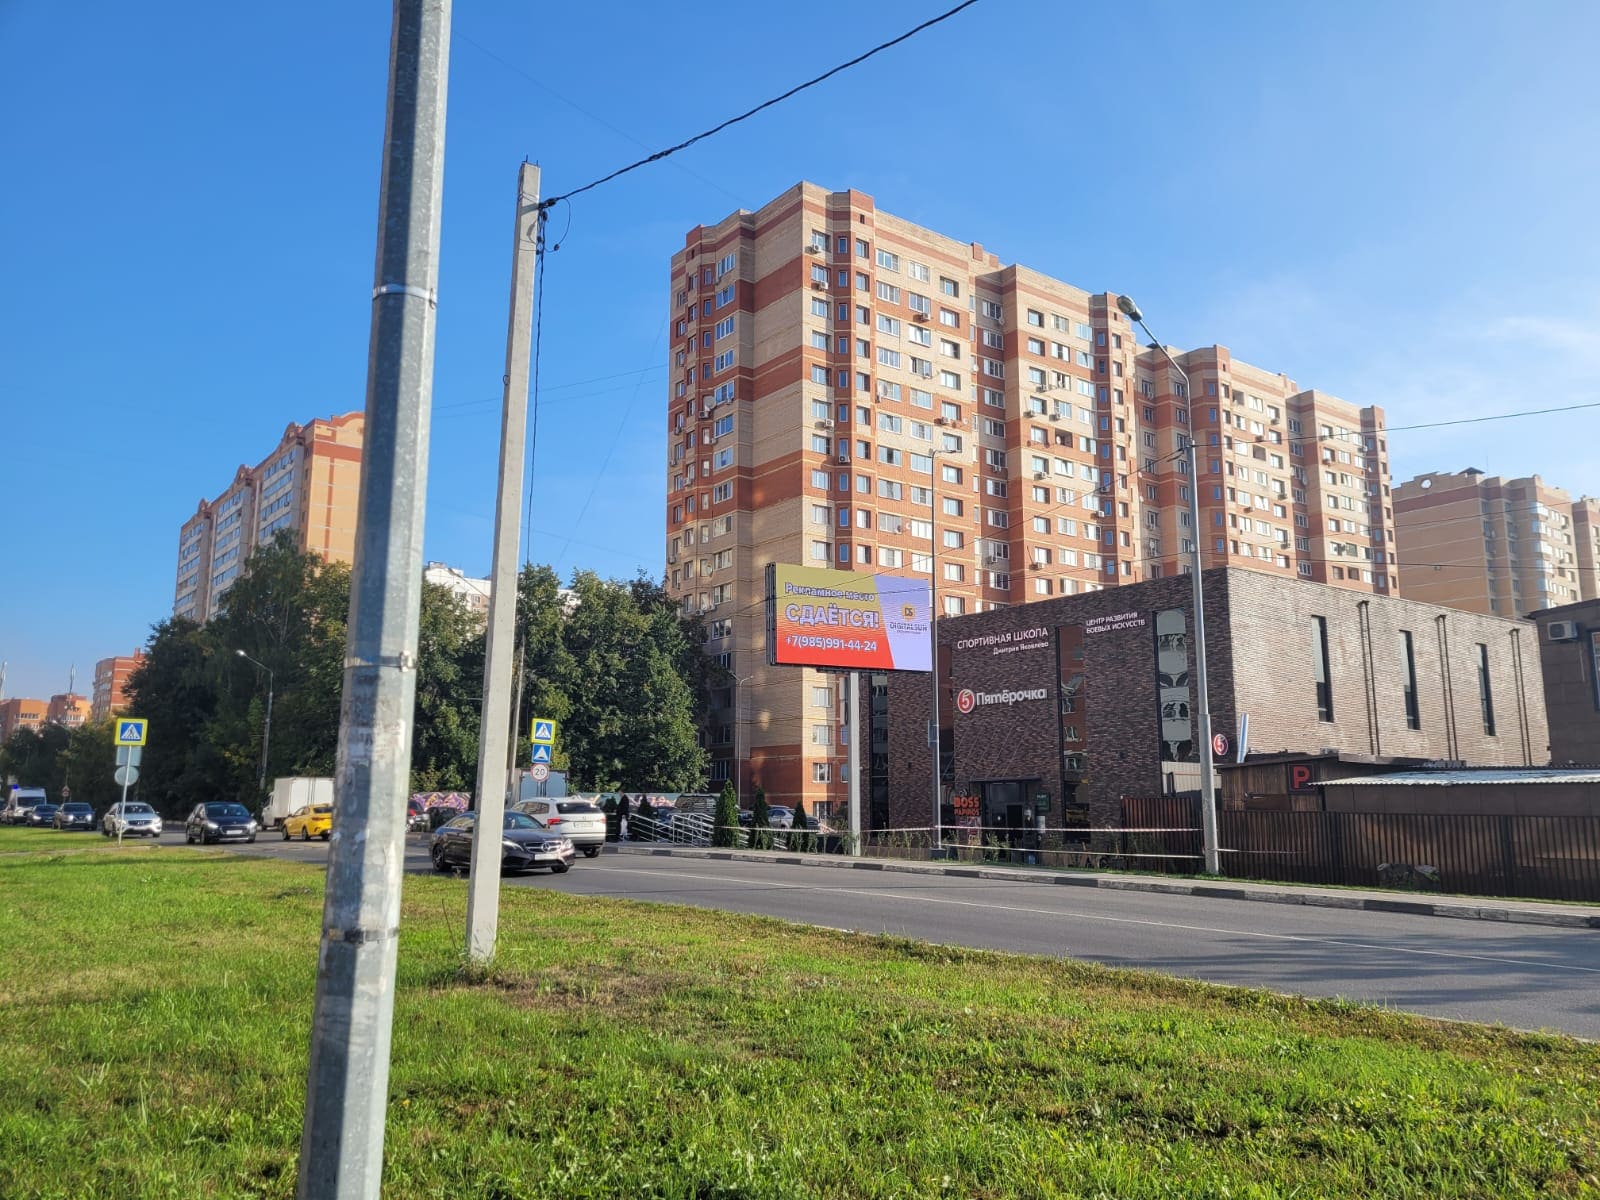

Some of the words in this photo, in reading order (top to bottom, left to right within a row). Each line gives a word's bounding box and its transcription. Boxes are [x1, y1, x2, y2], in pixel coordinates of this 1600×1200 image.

[785, 582, 844, 598] Рекламное
[845, 590, 875, 602] место
[785, 602, 880, 629] СДАЁТСЯ!
[1086, 617, 1105, 626] ЦЕНТР
[1105, 612, 1138, 623] РАЗВИТИЯ
[1086, 624, 1111, 634] БОЕВЫХ
[1112, 619, 1145, 630] ИСКУССТВ
[786, 635, 877, 652] +7(985)991-44-24
[957, 633, 1011, 649] СПОРТИВНАЯ
[1013, 627, 1049, 641] ШКОЛА
[976, 689, 1047, 705] Пятёрочка
[535, 768, 546, 776] 20
[1293, 766, 1310, 788] P
